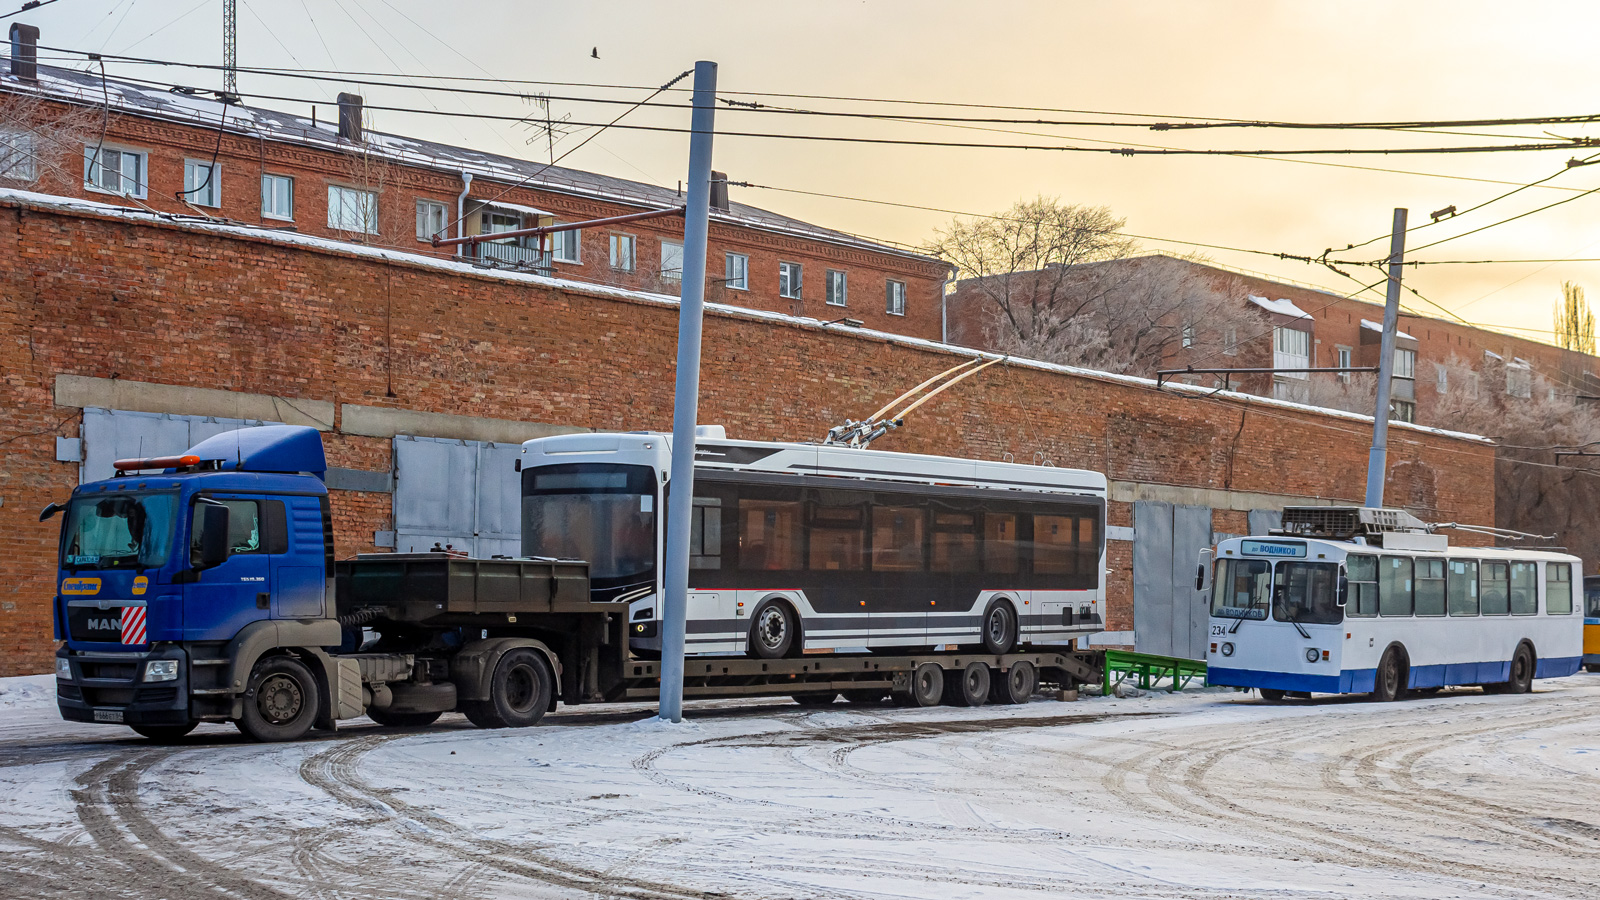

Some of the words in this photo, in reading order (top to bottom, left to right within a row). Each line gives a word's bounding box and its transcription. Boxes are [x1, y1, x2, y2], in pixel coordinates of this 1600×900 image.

[1260, 545, 1296, 555] ВОДНИКОВ
[88, 618, 122, 630] MAN
[1212, 626, 1226, 636] 234
